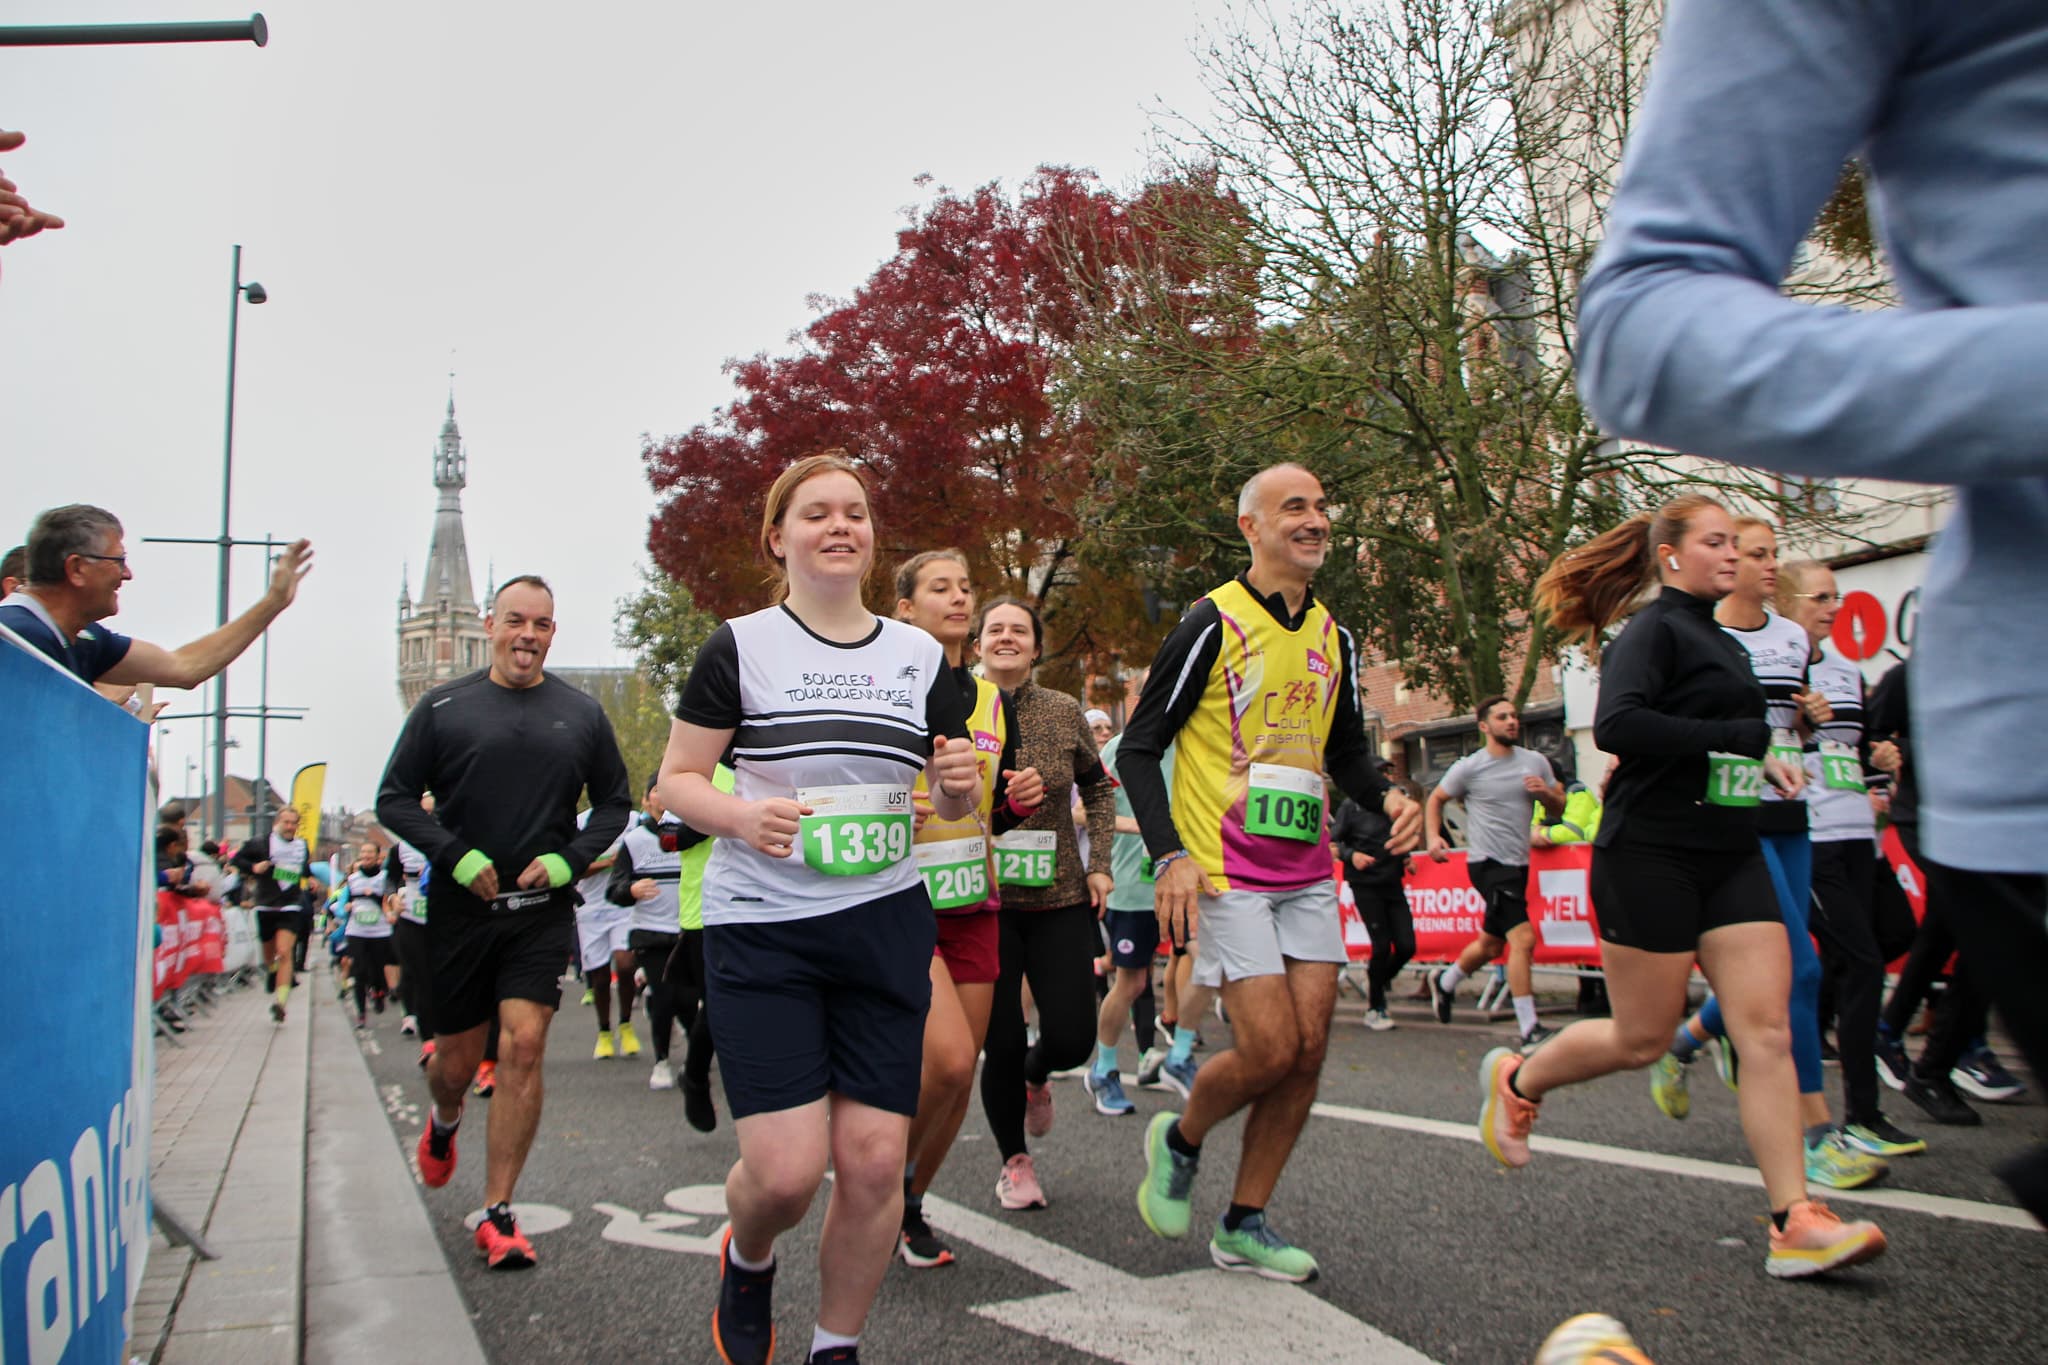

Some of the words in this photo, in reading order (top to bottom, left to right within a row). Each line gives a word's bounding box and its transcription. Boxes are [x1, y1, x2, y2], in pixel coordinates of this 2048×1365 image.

[802, 673, 871, 686] BOUCLES
[1716, 764, 1764, 797] 122
[888, 791, 907, 804] UST
[1255, 794, 1320, 833] 1039
[812, 821, 907, 864] 1339
[968, 842, 983, 852] UST
[1456, 916, 1474, 932] DE
